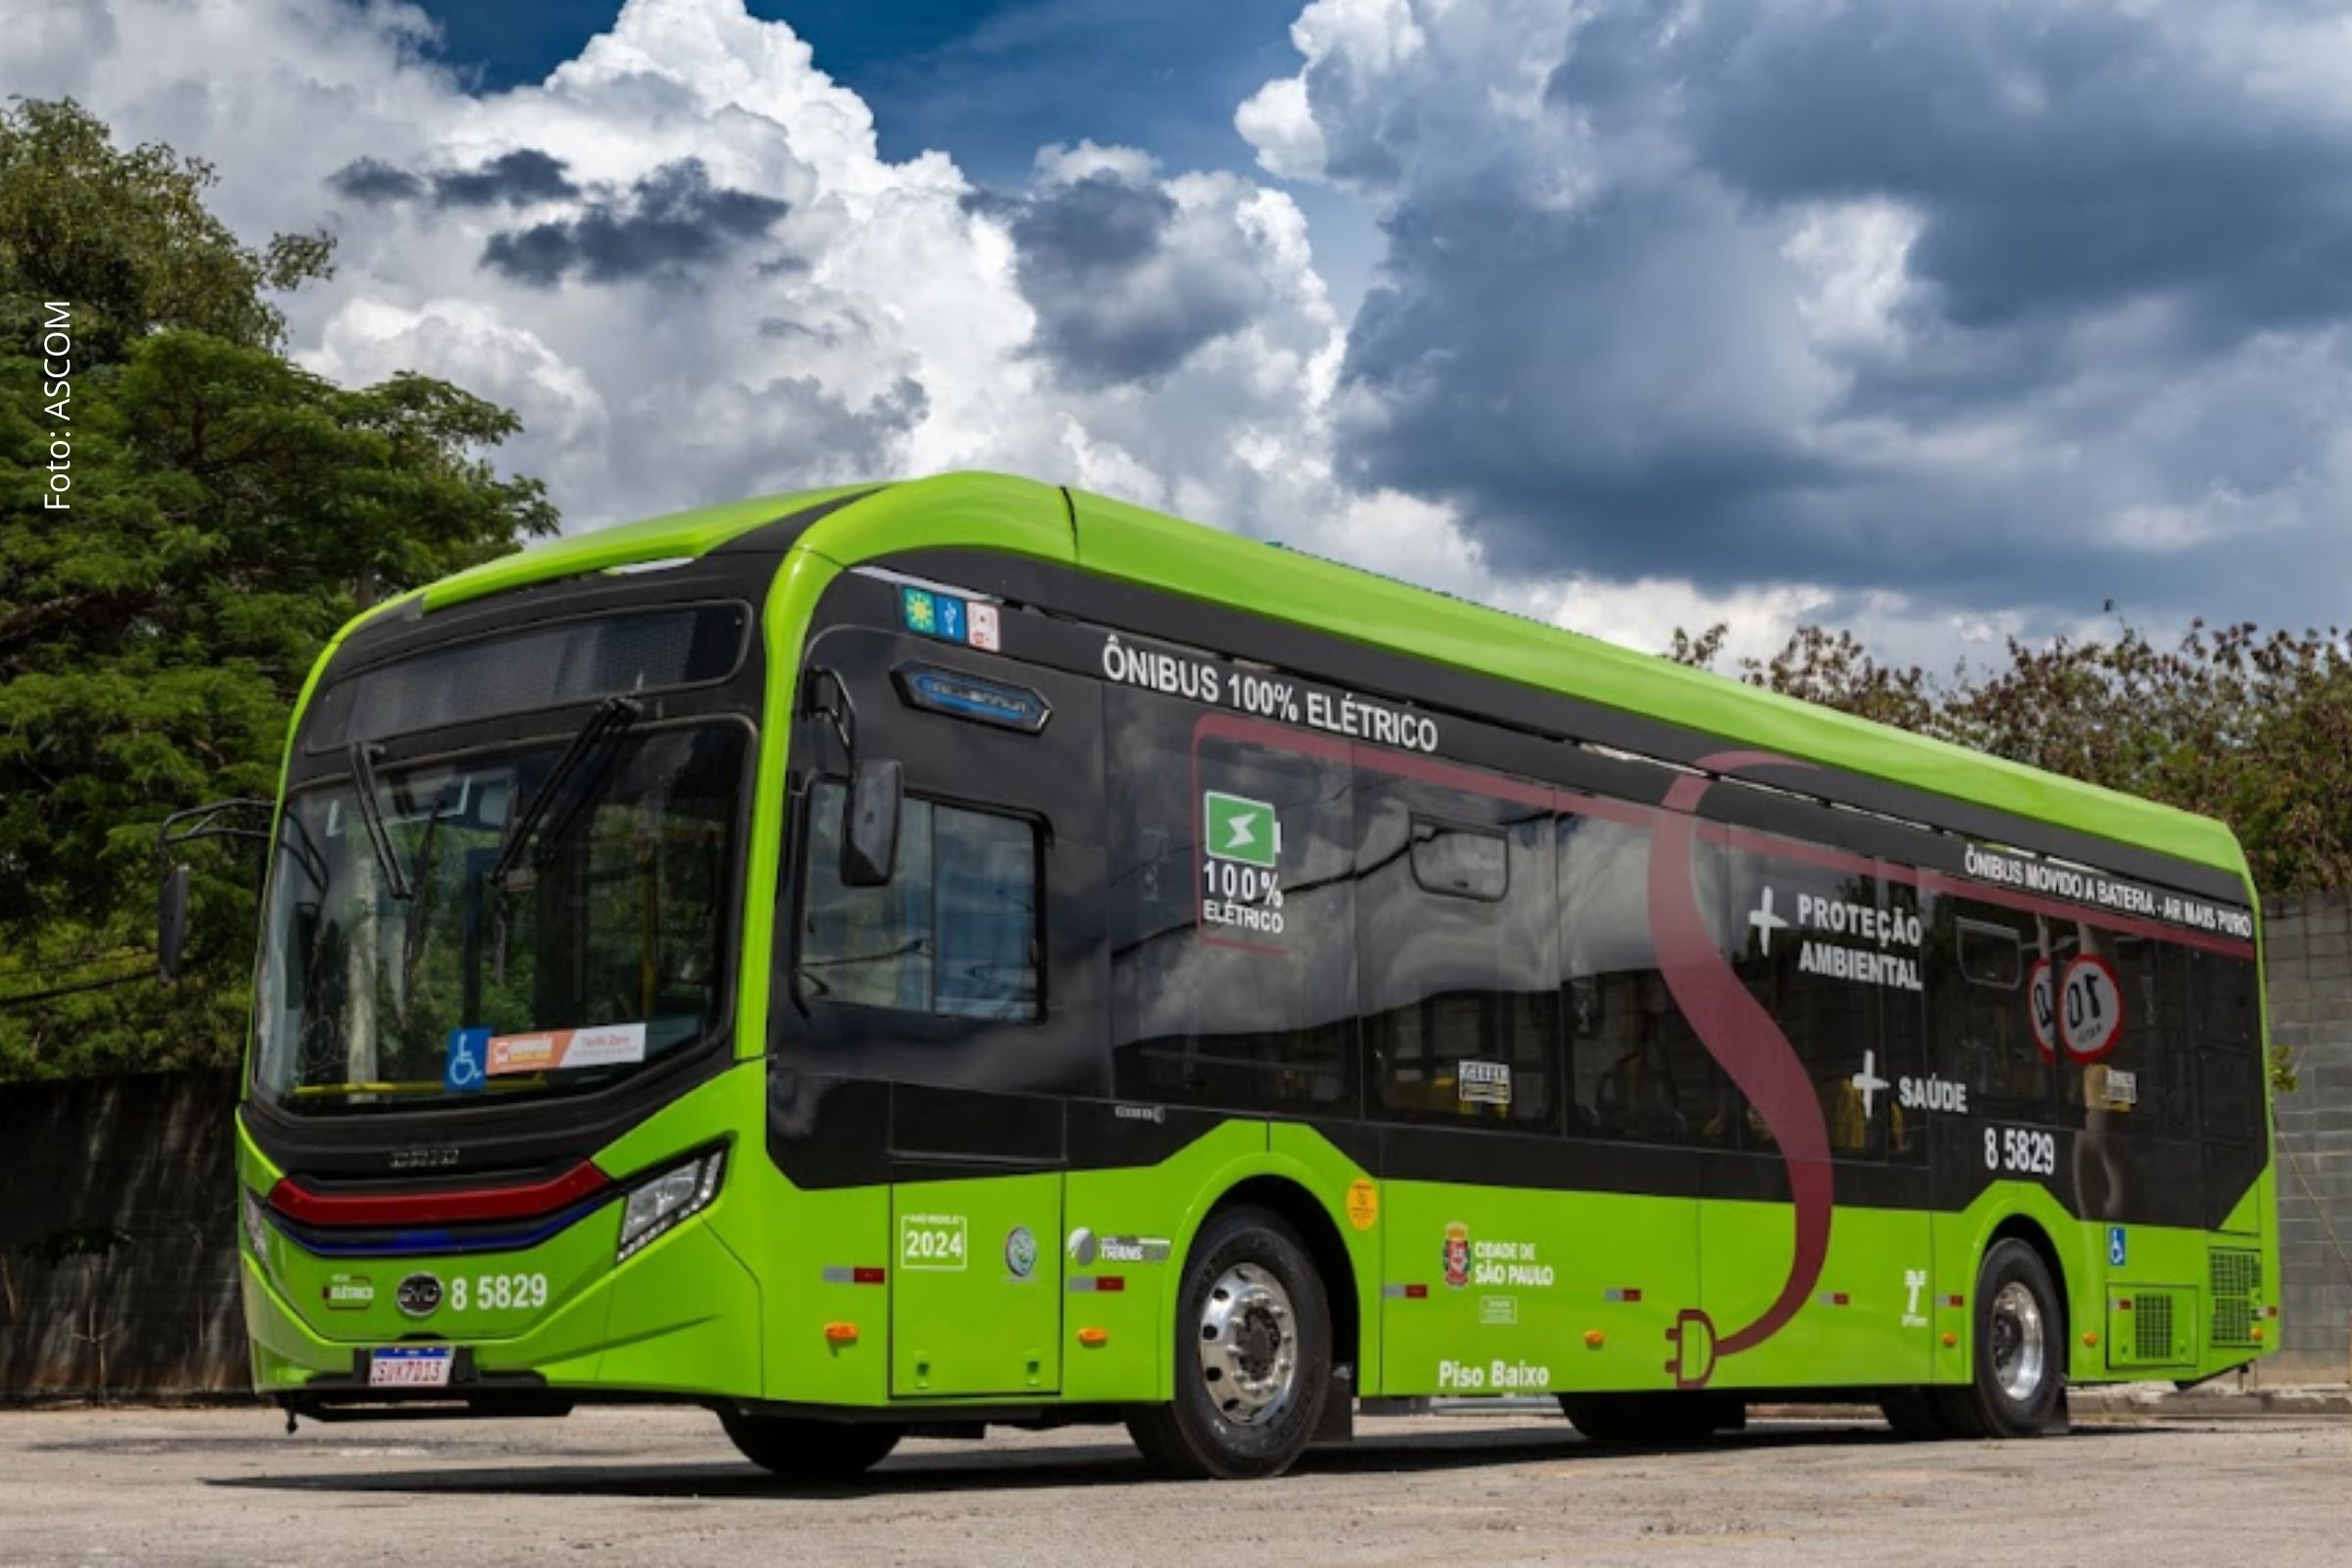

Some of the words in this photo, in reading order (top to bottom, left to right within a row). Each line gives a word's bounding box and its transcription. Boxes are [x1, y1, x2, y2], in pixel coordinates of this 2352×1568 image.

[1102, 635, 1219, 703] ÔNIBUS
[1228, 673, 1298, 722] 100%
[1307, 692, 1438, 752] ELÉTRICO
[1203, 859, 1284, 908] 100%
[1964, 843, 2024, 884] ÔNIBUS
[2026, 862, 2082, 899] MOVIDO
[2084, 878, 2096, 901] A
[2218, 909, 2252, 938] PURO
[1203, 899, 1284, 933] ELÉTRICO
[1797, 893, 1922, 948] PROTEÇÃO
[1798, 941, 1923, 991] AMBIENTAL
[1899, 1073, 1968, 1113] SAÚDE
[1984, 1127, 1998, 1170] 8
[2004, 1128, 2054, 1175] 5829
[906, 1231, 962, 1257] 2024
[1475, 1241, 1518, 1260] CIDADE
[1520, 1243, 1536, 1260] DE
[452, 1277, 467, 1311] 8
[477, 1273, 547, 1310] 5829
[1475, 1260, 1505, 1284] SÃO
[1508, 1264, 1554, 1286] PAULO
[1439, 1360, 1485, 1388] Piso
[1491, 1359, 1550, 1388] Baixo
